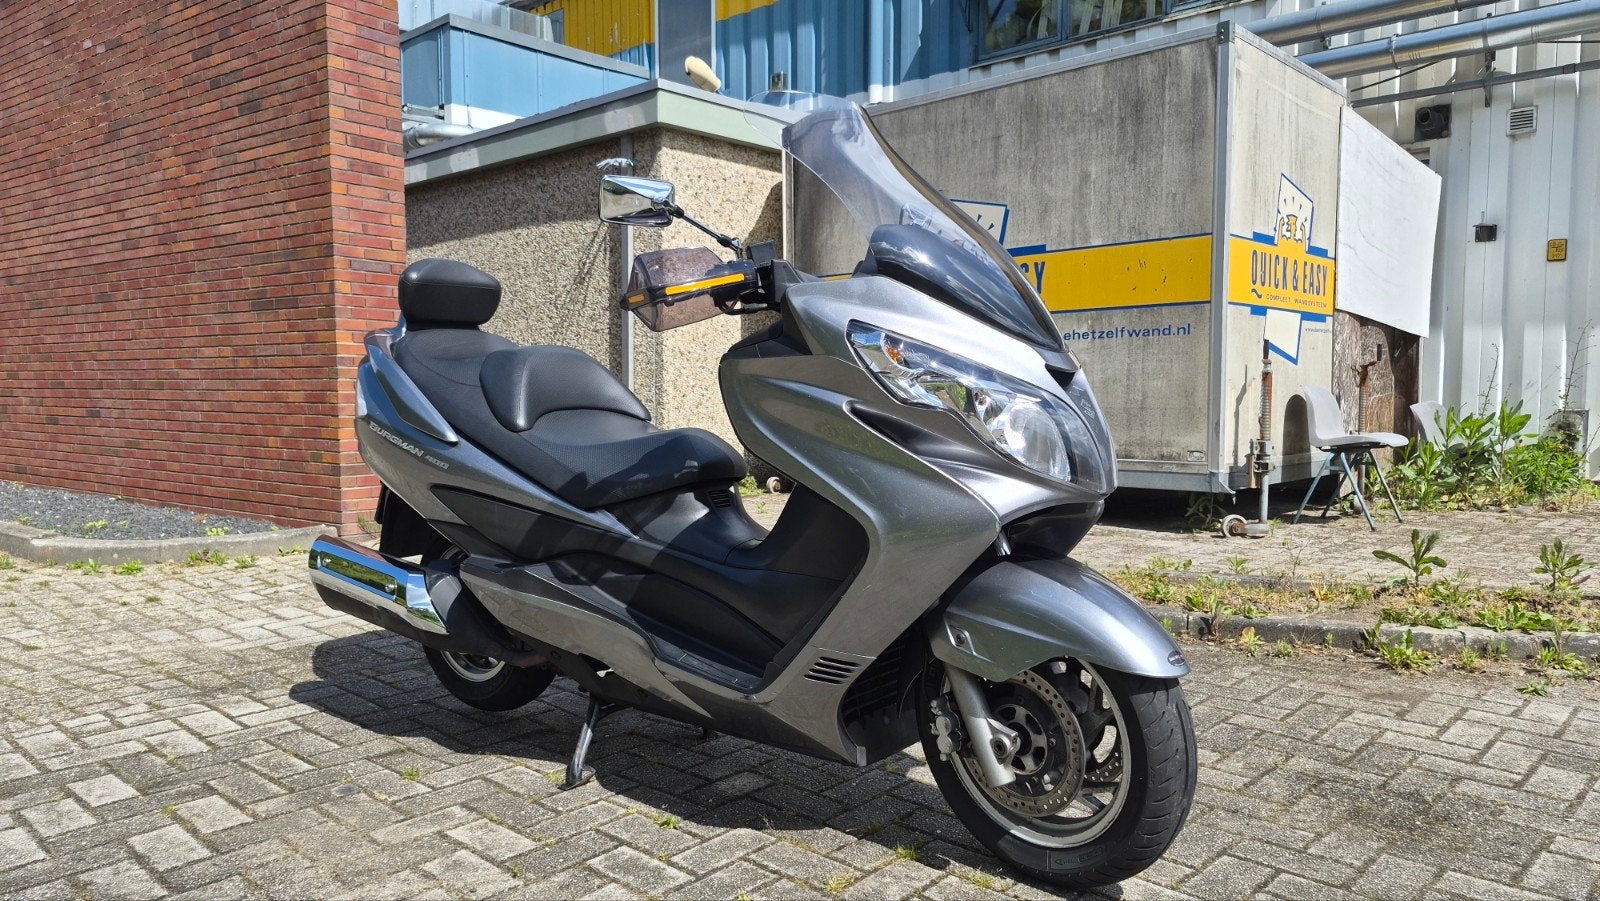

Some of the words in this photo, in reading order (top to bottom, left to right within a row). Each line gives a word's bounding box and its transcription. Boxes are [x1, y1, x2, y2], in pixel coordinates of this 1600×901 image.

[1020, 261, 1046, 294] Y
[1251, 249, 1289, 299] QUICK
[1292, 259, 1299, 292] &
[1302, 260, 1328, 297] EASY
[1063, 323, 1191, 340] ehetzelfwand.nl
[369, 421, 425, 457] BURGMAN
[425, 455, 450, 470] 400
